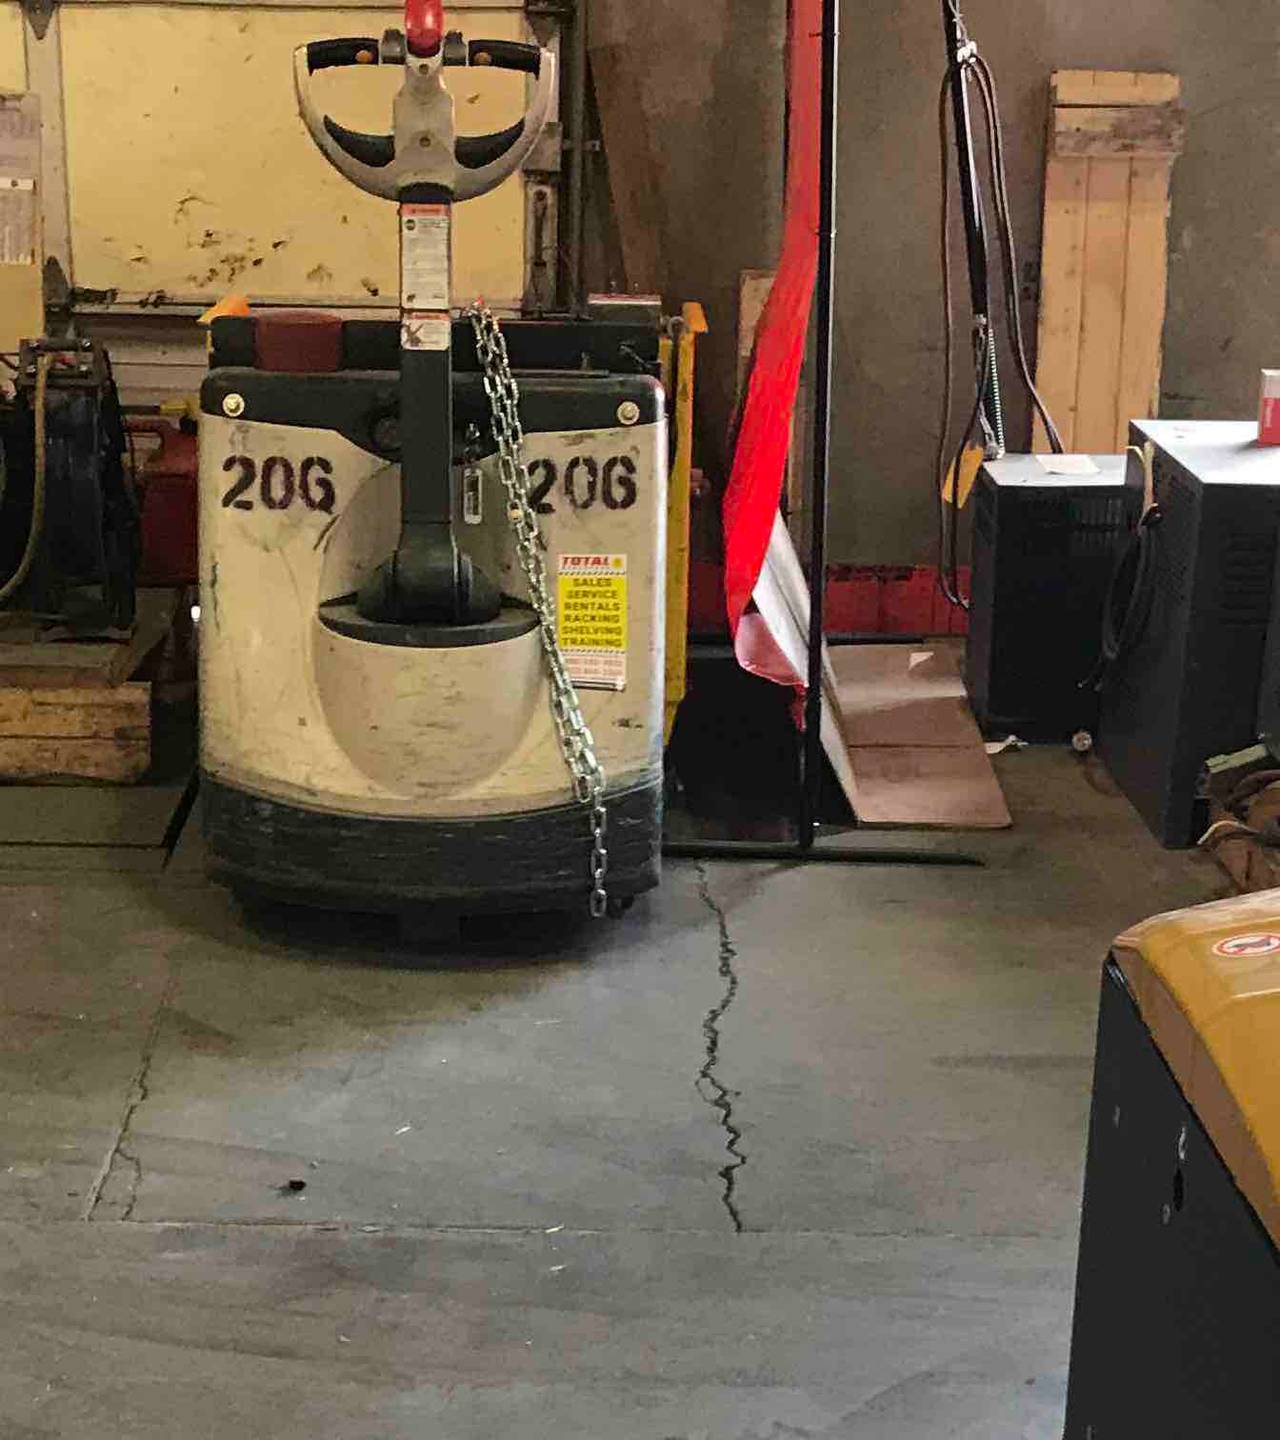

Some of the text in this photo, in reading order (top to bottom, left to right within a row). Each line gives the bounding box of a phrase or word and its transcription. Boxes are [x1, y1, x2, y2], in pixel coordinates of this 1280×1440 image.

[221, 455, 336, 513] 206
[524, 456, 638, 513] 206
[562, 556, 609, 566] TOTAL
[572, 578, 612, 587] SALES
[565, 590, 618, 599] SERVICE
[564, 602, 620, 611] RENTALS
[564, 614, 620, 623] RACKING
[561, 626, 622, 635] SHELVING
[561, 637, 622, 647] TRAINING
